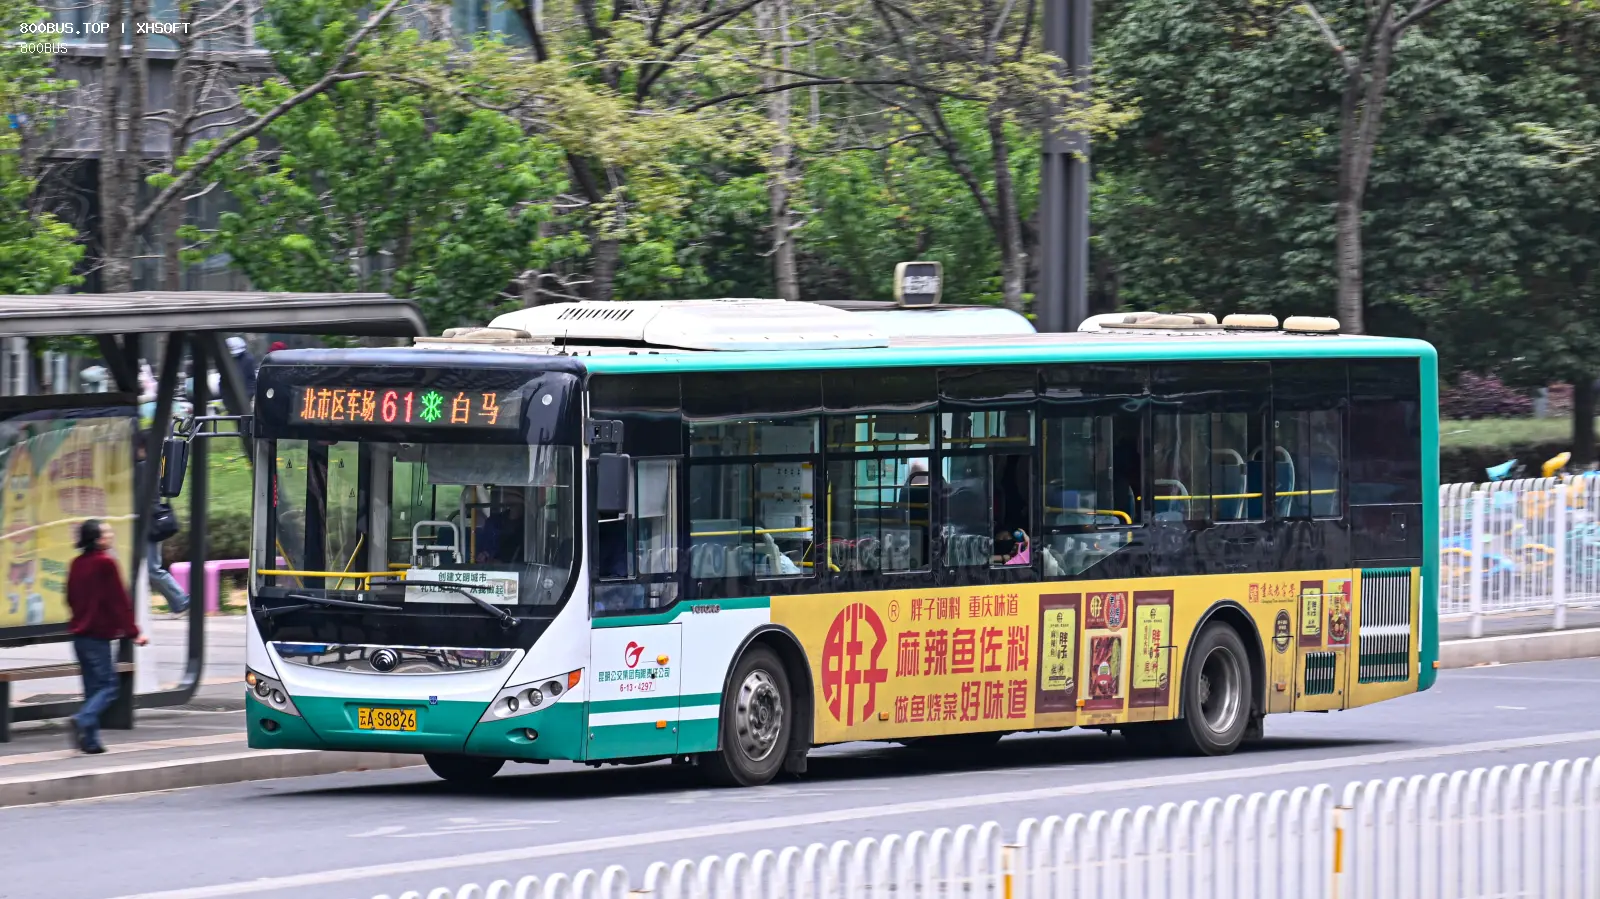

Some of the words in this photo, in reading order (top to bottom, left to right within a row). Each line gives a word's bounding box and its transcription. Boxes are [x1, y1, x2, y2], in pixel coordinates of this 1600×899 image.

[301, 388, 376, 421] 北市区车场
[381, 390, 414, 423] 61
[438, 572, 487, 583] 创建文明城市
[911, 597, 961, 622] 胖子调料
[969, 593, 1019, 619] 重庆味道
[895, 624, 1030, 678] 麻辣鱼佐料
[598, 667, 670, 682] 昆明公交集团有限责任公司
[894, 678, 1029, 724] 做鱼烧菜好味道
